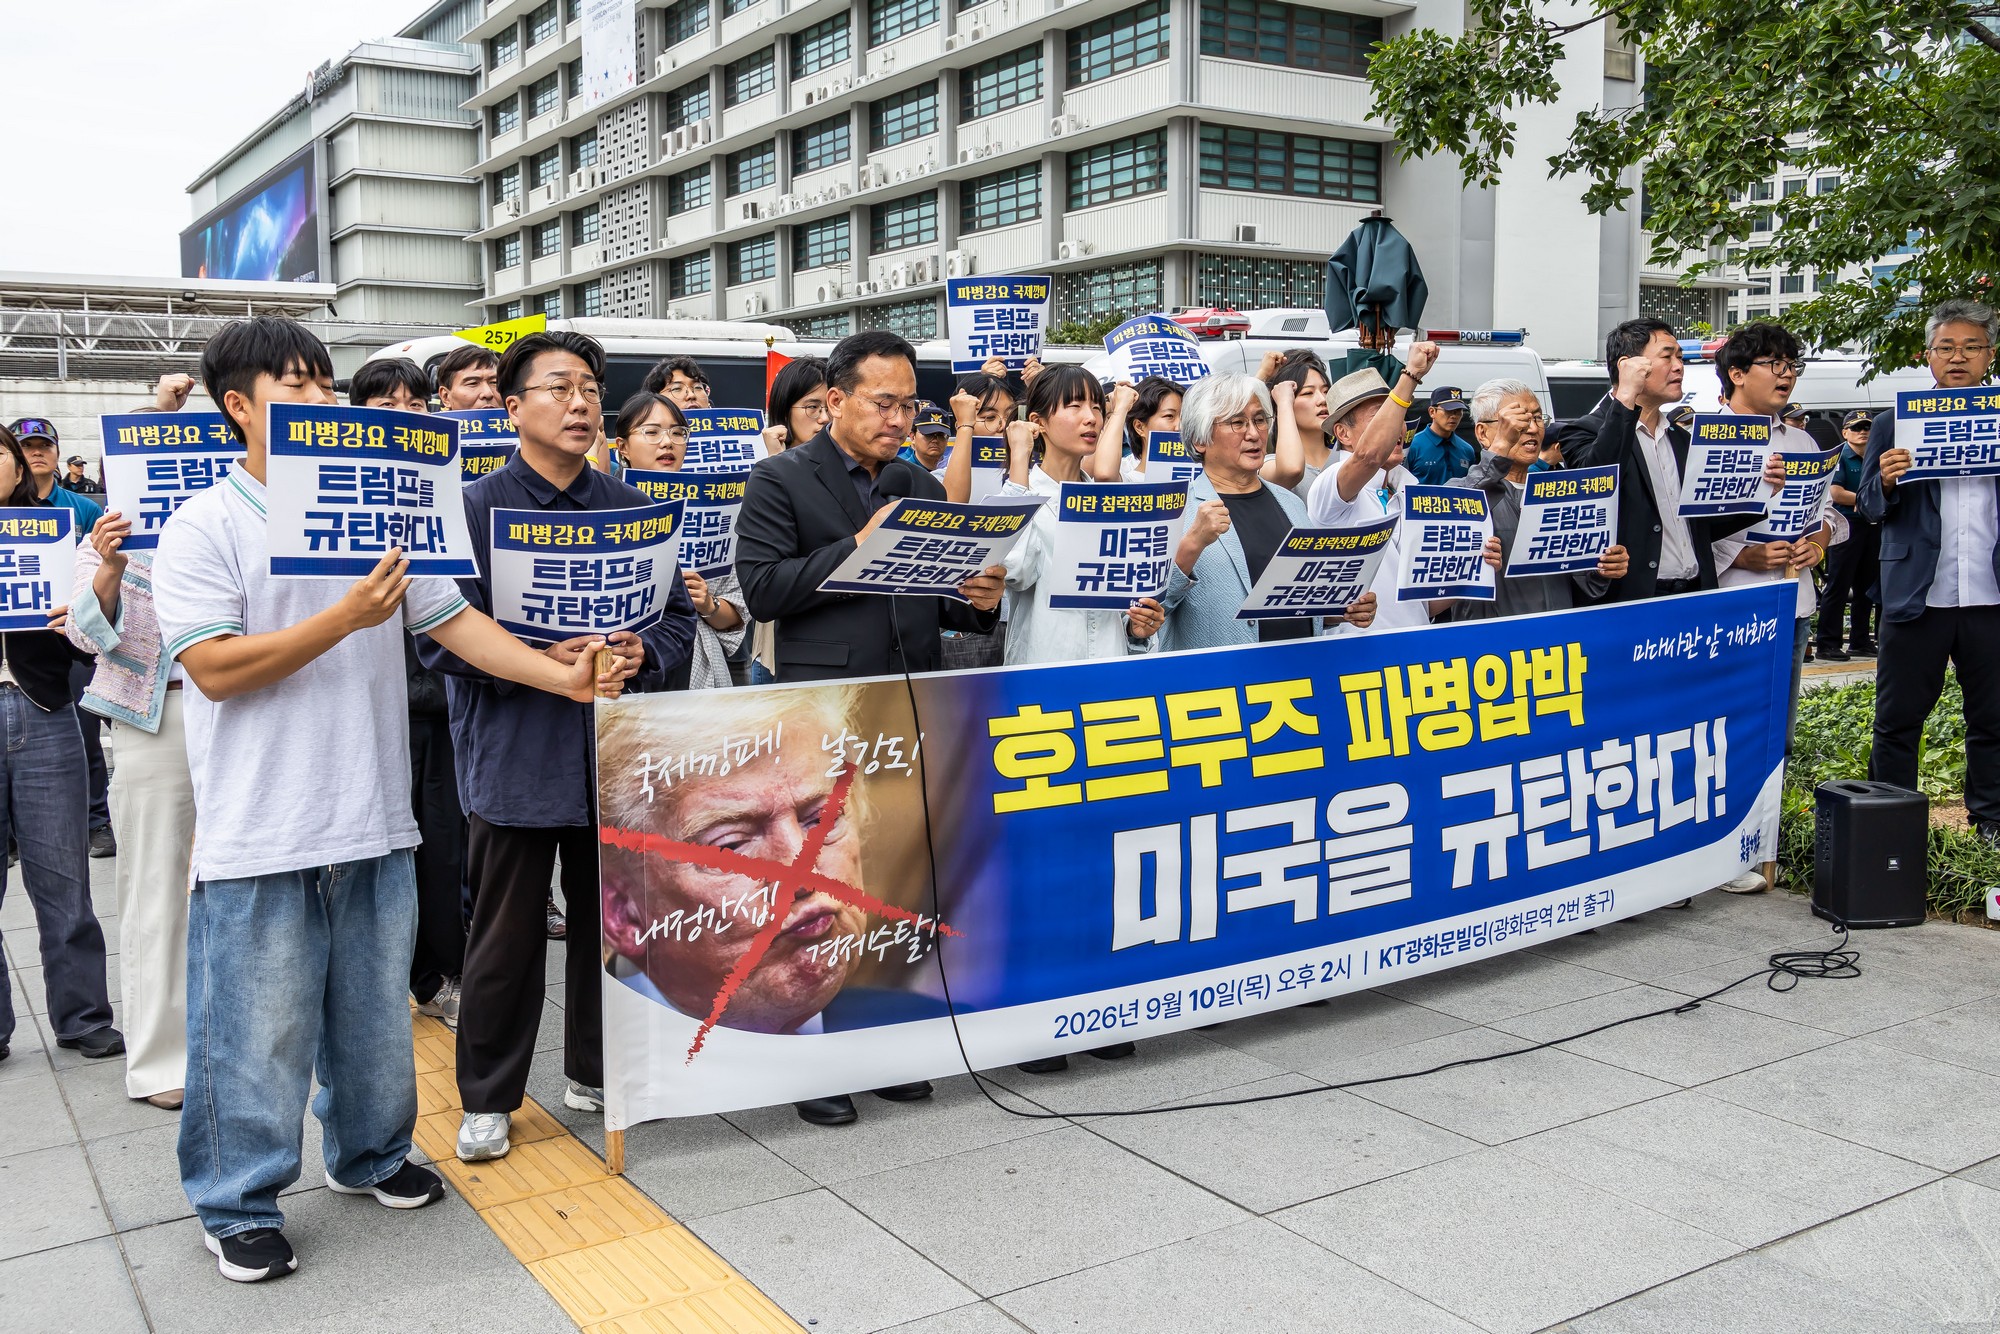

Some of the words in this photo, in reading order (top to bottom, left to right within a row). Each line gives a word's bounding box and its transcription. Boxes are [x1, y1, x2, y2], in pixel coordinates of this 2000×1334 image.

[957, 284, 1010, 301] 파병강요
[974, 308, 1039, 331] 트럼프를
[485, 330, 518, 344] 25기
[1112, 322, 1160, 346] 파병강요
[1461, 332, 1490, 341] POLICE
[1128, 341, 1201, 361] 트럼프를
[1907, 397, 1967, 413] 파병강요
[118, 424, 203, 446] 파병강요
[716, 416, 760, 431] 국제깡패
[1699, 423, 1737, 440] 파병강요
[1923, 419, 2000, 443] 트럼프
[288, 420, 387, 448] 파병강요
[392, 426, 449, 457] 국제깡패
[1703, 450, 1763, 473] 트럼프를
[317, 464, 434, 508] 트럼프를
[636, 480, 699, 500] 파병강요
[703, 481, 746, 500] 국제깡패
[1533, 480, 1577, 498] 파병강요
[1580, 475, 1614, 494] 국제깡패
[1693, 477, 1762, 501] 규탄한다!
[1066, 495, 1098, 513] 이란
[1101, 494, 1154, 513] 침략전쟁
[1155, 492, 1186, 511] 파병강요
[1412, 495, 1451, 514] 파병강요
[508, 523, 596, 546] 파병강요
[602, 513, 673, 545] 국제깡패
[897, 509, 966, 529] 파병강요
[968, 513, 1026, 532] 국제깡패
[1539, 504, 1606, 532] 트럼프를
[304, 511, 447, 554] 규탄한다!
[1099, 525, 1169, 558] 미국을
[1287, 536, 1315, 551] 이란
[1313, 534, 1361, 550] 침략전쟁
[1421, 525, 1483, 552] 트럼프를
[885, 535, 991, 566] 트럼프를
[531, 556, 653, 592] 트럼프를
[1293, 559, 1365, 583] 미국을
[1411, 555, 1483, 583] 규탄한다!
[521, 584, 657, 629] 규탄한다!
[1263, 584, 1364, 607] 규탄한다!
[1633, 626, 1703, 662] 미대사관
[1706, 623, 1724, 659] 앞
[1726, 613, 1777, 646] 기자회견
[987, 677, 1325, 814] 호르무즈
[1339, 641, 1588, 762] 파병압박
[634, 720, 782, 803] 국제깡패!
[821, 727, 925, 778] 날강도!
[1111, 782, 1414, 953] 미국을
[1441, 716, 1728, 889] 규탄한다!
[635, 881, 780, 946] 내정간섭!
[806, 913, 940, 967] 경제수탈!
[1054, 998, 1139, 1039] 2026년
[1146, 990, 1182, 1020] 9월
[1189, 974, 1271, 1012] 10일(목)
[1277, 963, 1316, 992] 오후
[1321, 953, 1352, 983] 2시
[1379, 904, 1553, 970] KT광화문빌딩(광화문역
[1556, 897, 1580, 924] 2번
[1583, 888, 1615, 917] 출구)
